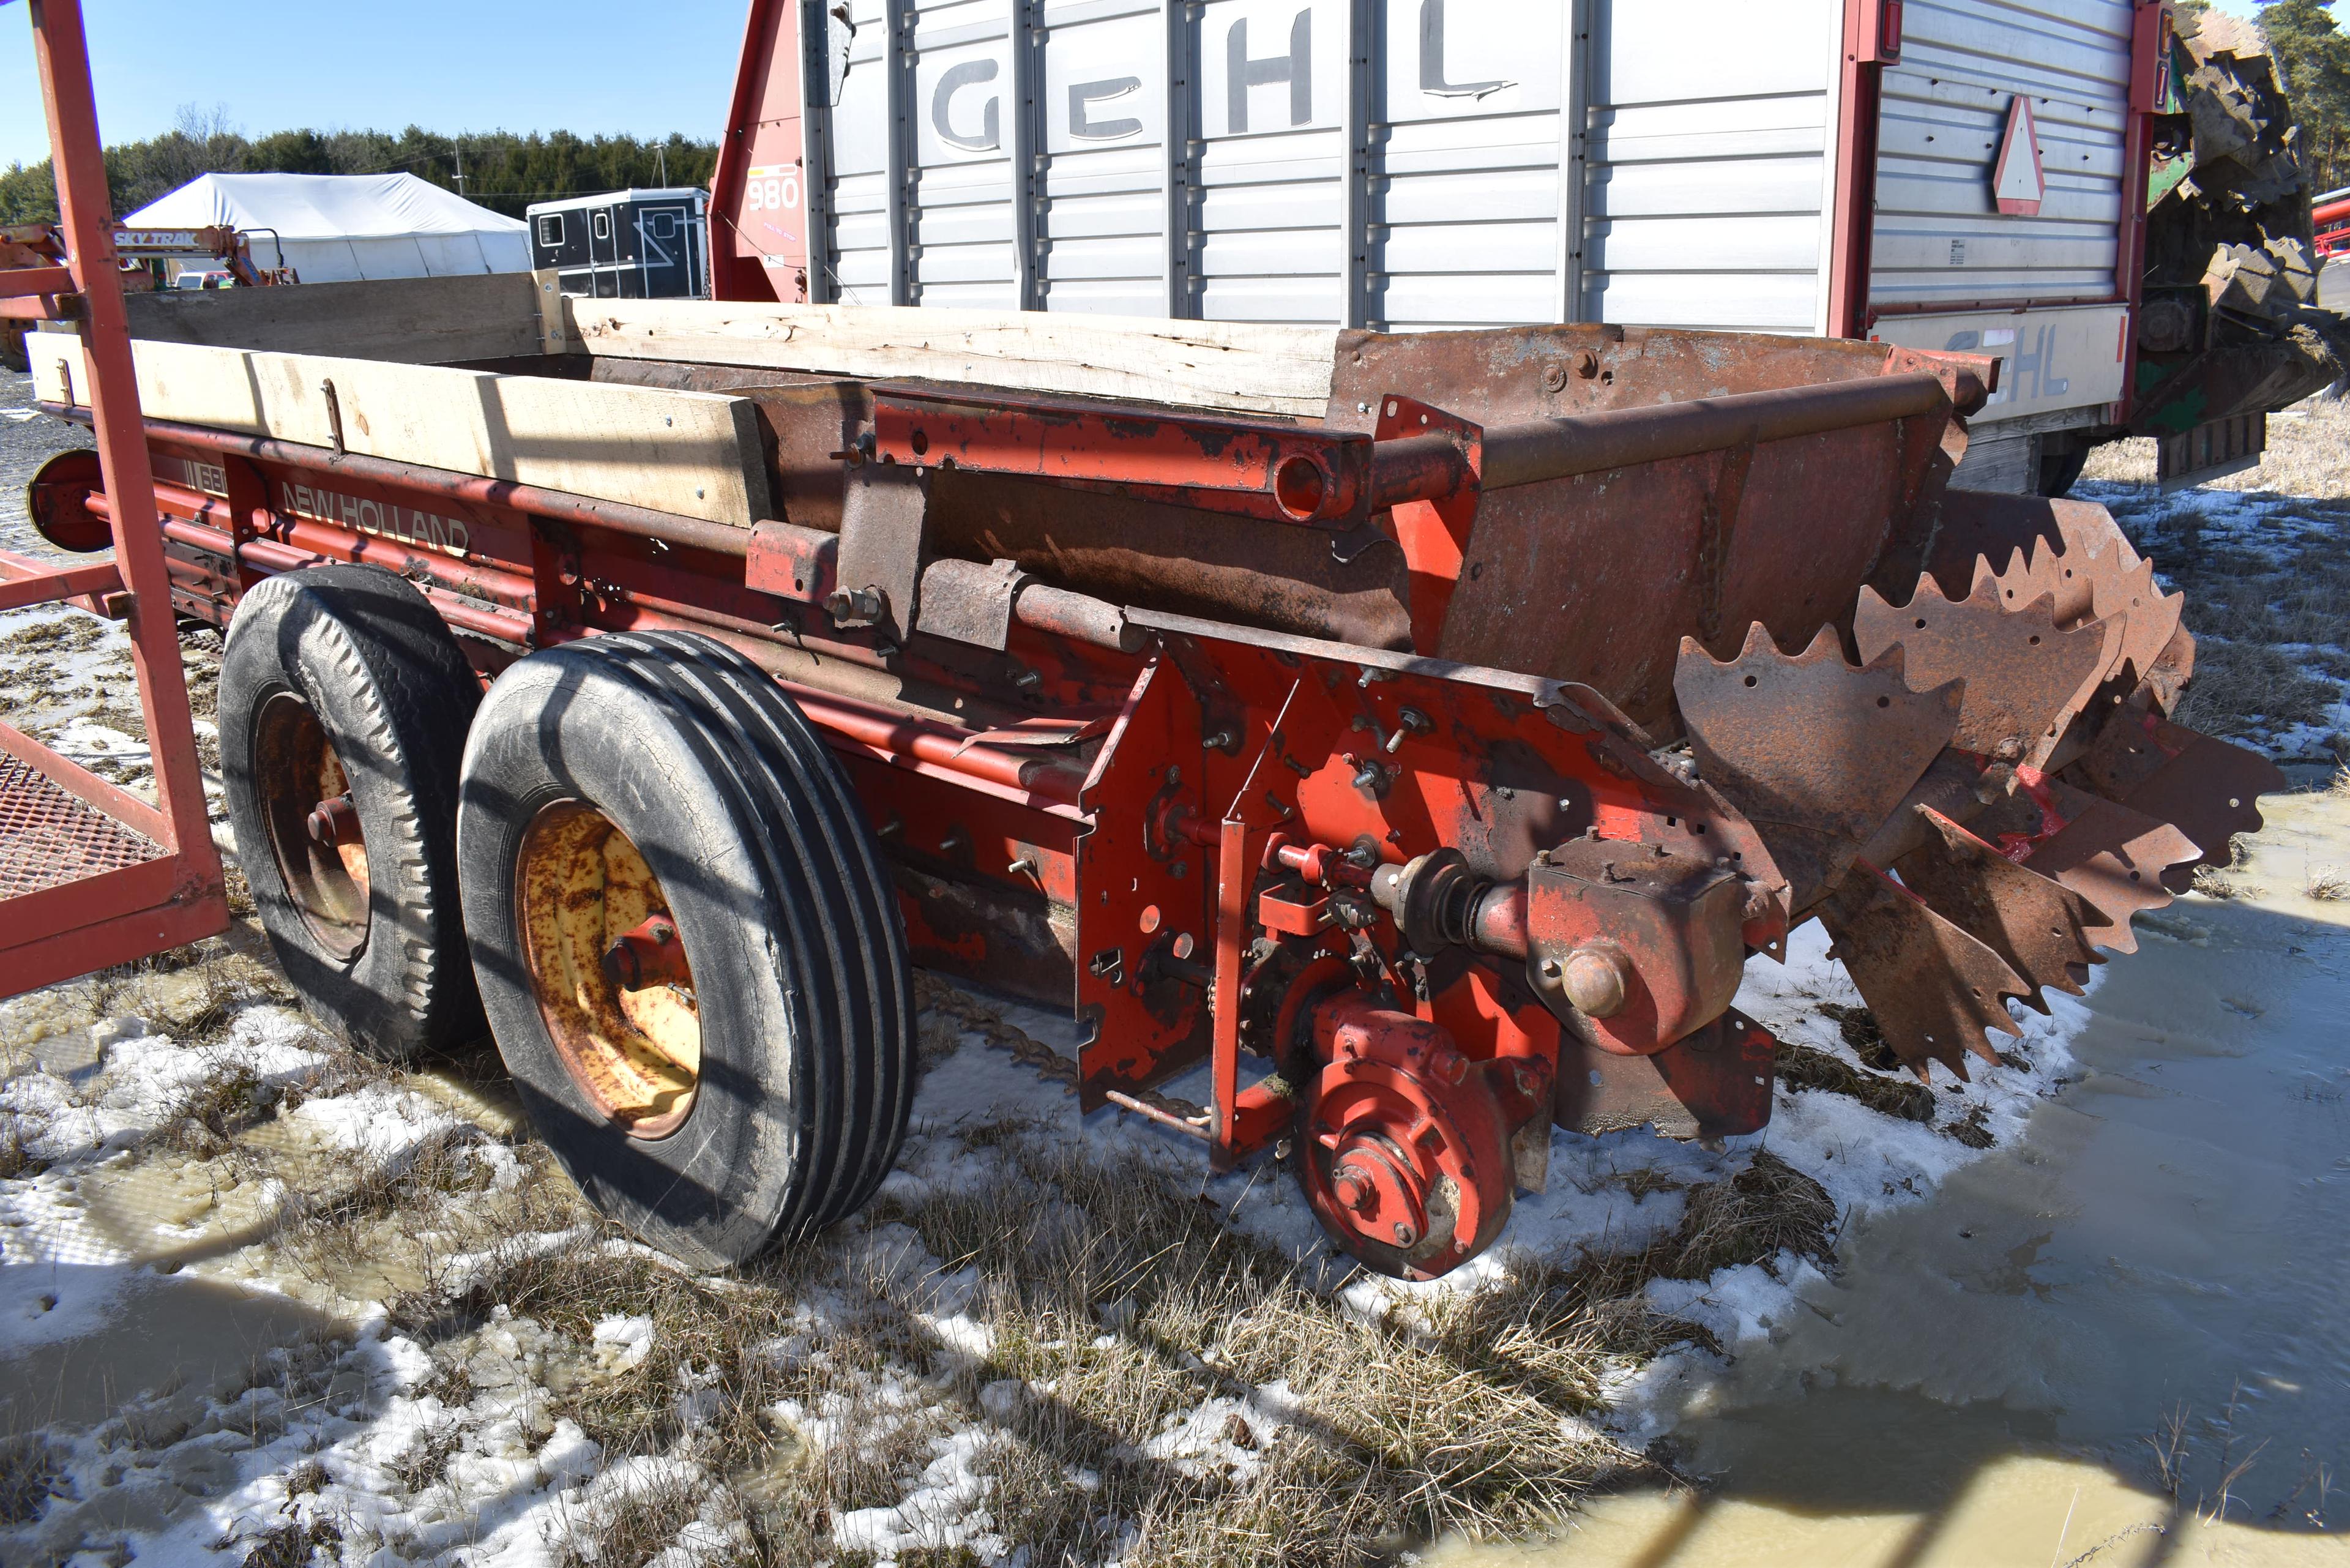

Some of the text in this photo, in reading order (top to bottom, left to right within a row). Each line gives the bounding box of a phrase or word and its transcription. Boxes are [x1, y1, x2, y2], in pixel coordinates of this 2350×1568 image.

[748, 177, 799, 211] 980
[114, 233, 199, 245] SKY TRAK
[783, 231, 796, 241] STOP
[282, 481, 469, 557] NEW HOLLAND
